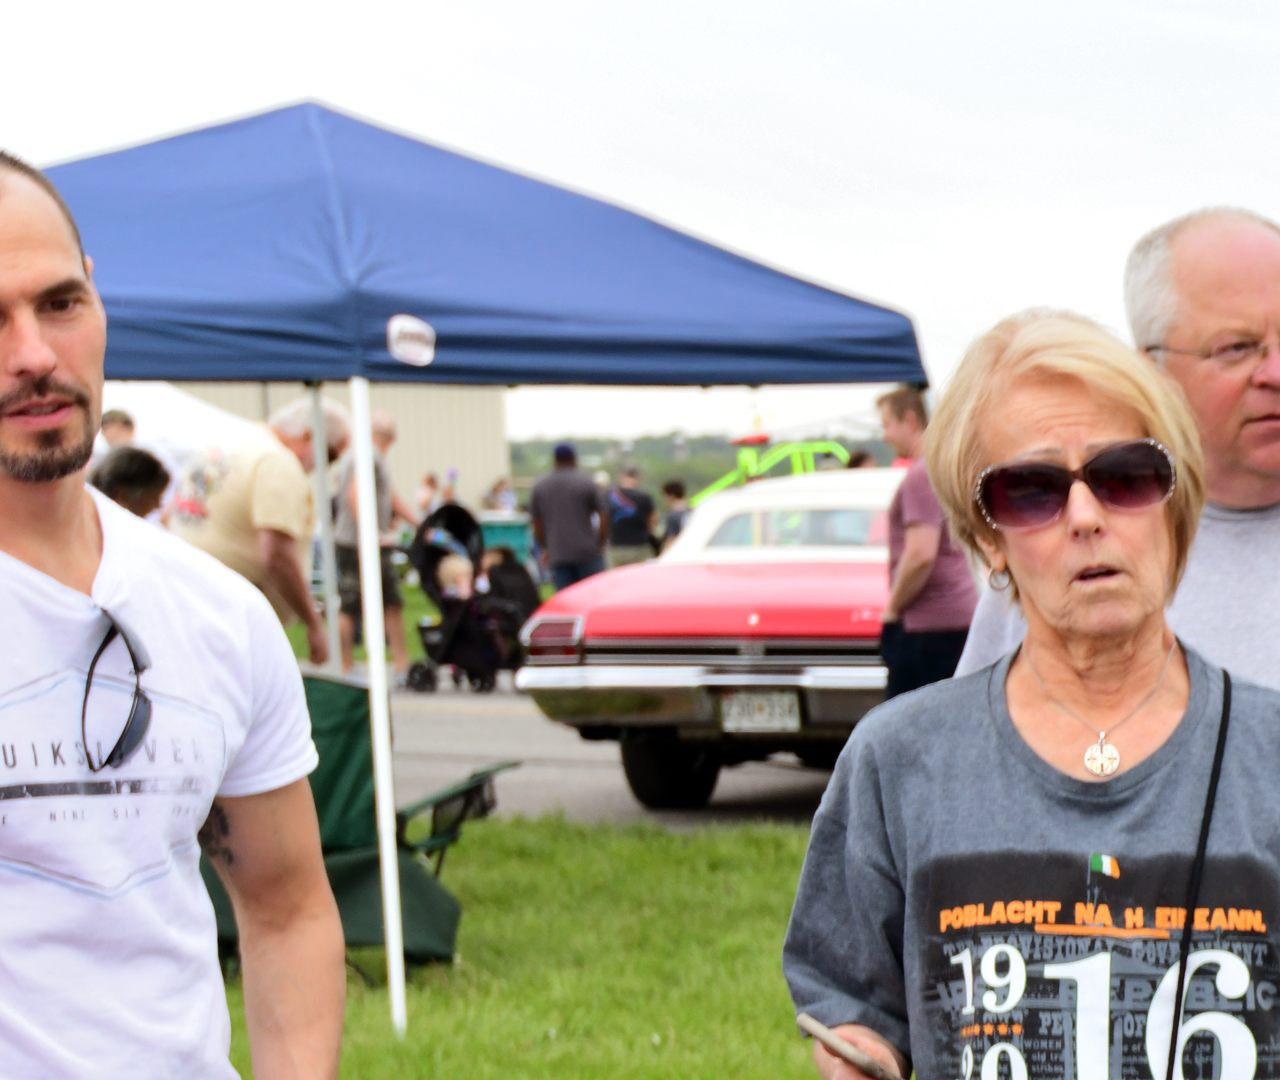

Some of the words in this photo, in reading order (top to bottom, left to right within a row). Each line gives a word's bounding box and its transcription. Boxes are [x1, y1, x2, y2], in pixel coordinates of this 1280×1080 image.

[939, 900, 1061, 933] POBLACHT
[1074, 902, 1113, 927] NA
[1125, 907, 1144, 929] H
[950, 943, 1027, 1015] 19
